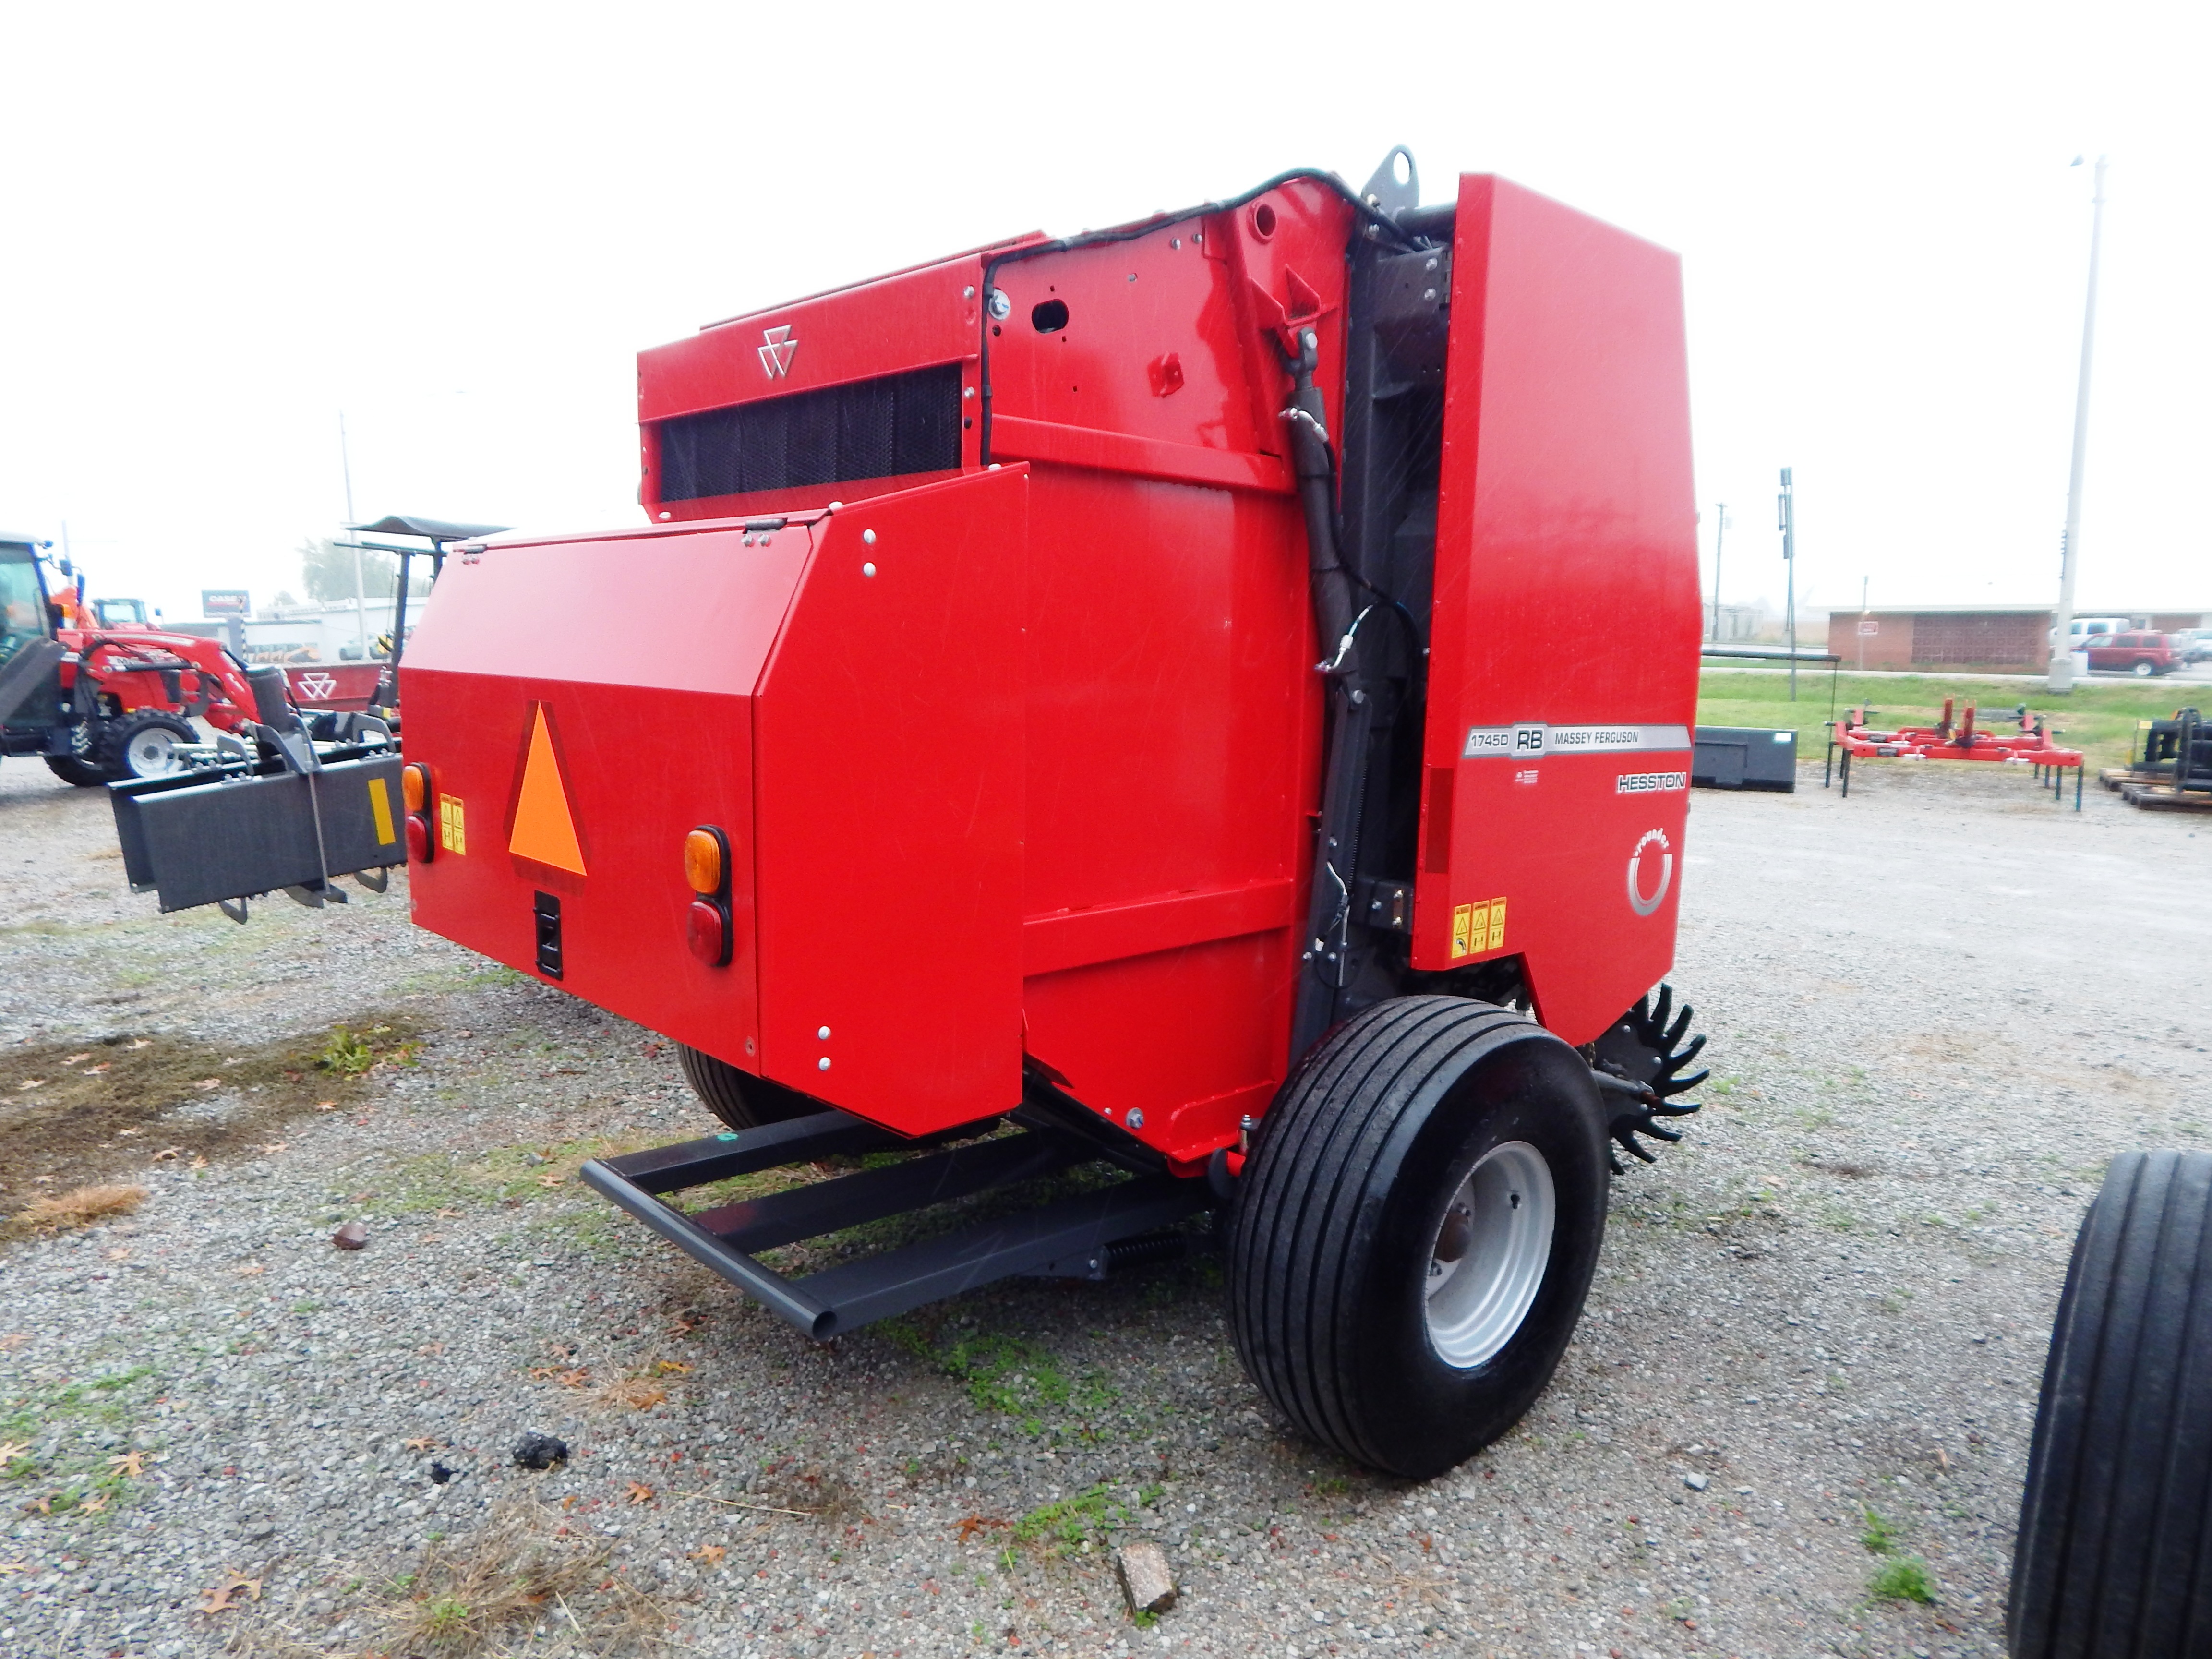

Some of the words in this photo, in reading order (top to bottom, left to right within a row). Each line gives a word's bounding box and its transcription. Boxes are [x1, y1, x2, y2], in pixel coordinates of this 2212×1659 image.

[1471, 733, 1509, 747] 1745D
[1516, 729, 1543, 750] RB
[1555, 732, 1592, 745] MASSEY
[1594, 731, 1639, 744] FERGUSON
[1618, 772, 1686, 792] HESSTON
